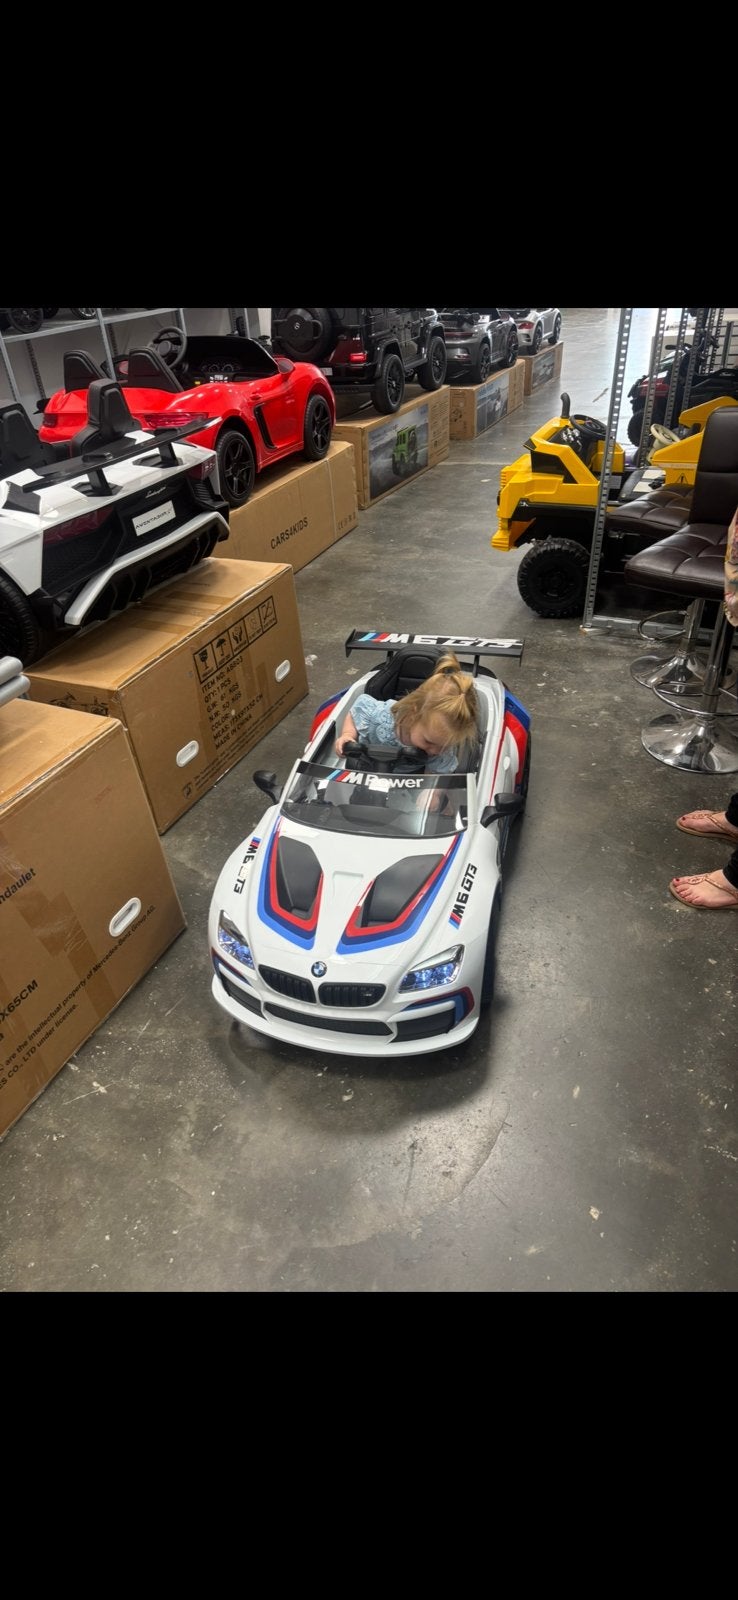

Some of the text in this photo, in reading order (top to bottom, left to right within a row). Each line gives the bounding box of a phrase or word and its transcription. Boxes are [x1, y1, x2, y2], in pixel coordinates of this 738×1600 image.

[270, 516, 309, 550] CARS4KIDS
[202, 679, 215, 694] ITEM
[221, 678, 231, 689] PCS
[215, 733, 231, 750] MADE
[237, 714, 252, 731] CHINA
[460, 862, 478, 892] GT3
[5, 1053, 17, 1066] are
[16, 1040, 29, 1053] the
[28, 1003, 62, 1041] intellectual
[62, 979, 87, 1006] property
[131, 914, 147, 932] Group
[22, 1046, 36, 1063] LTD
[36, 1027, 55, 1048] under
